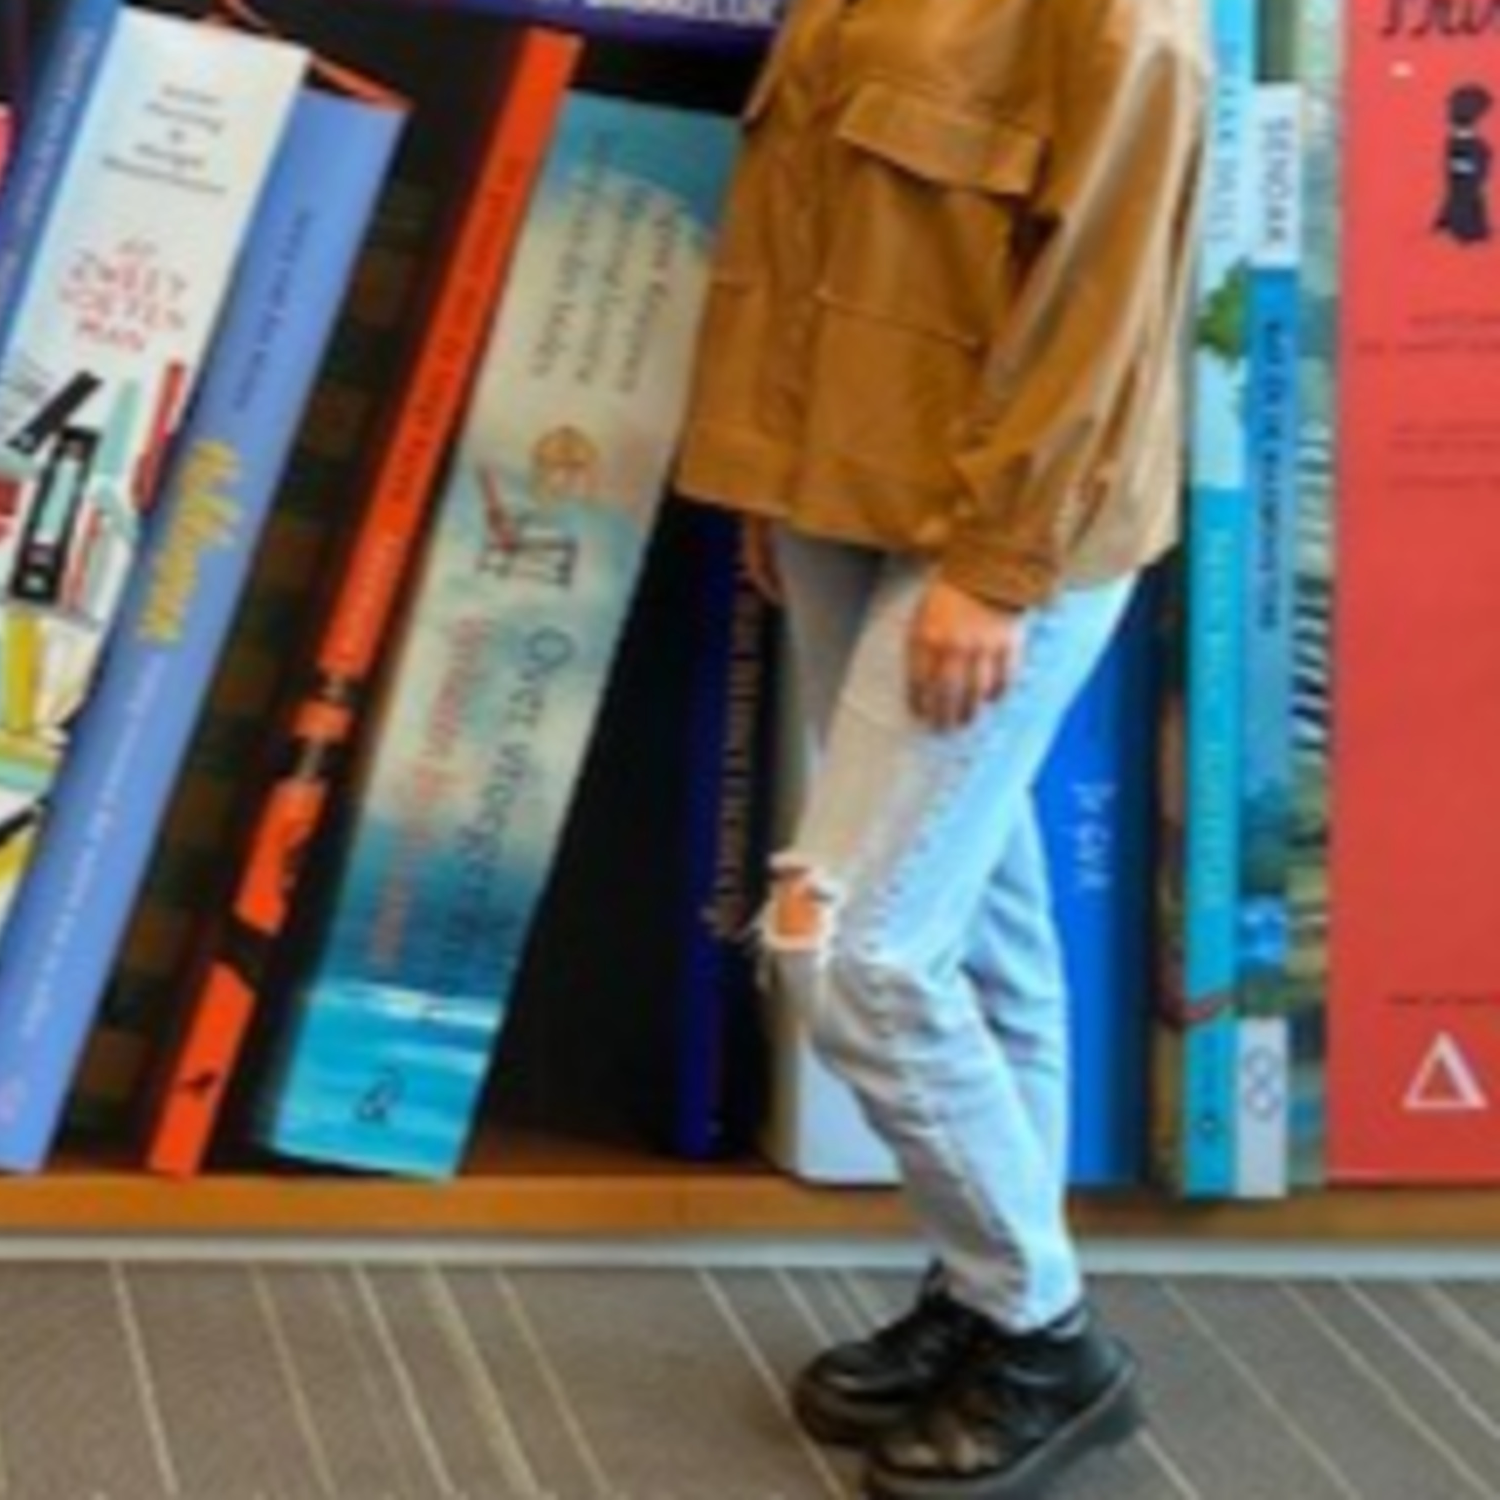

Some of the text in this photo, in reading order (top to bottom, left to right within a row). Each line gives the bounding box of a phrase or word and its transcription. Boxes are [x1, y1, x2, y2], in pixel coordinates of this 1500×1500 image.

[1260, 118, 1292, 245] SENDAK
[502, 621, 578, 736] Over
[448, 733, 532, 895] vroeger
